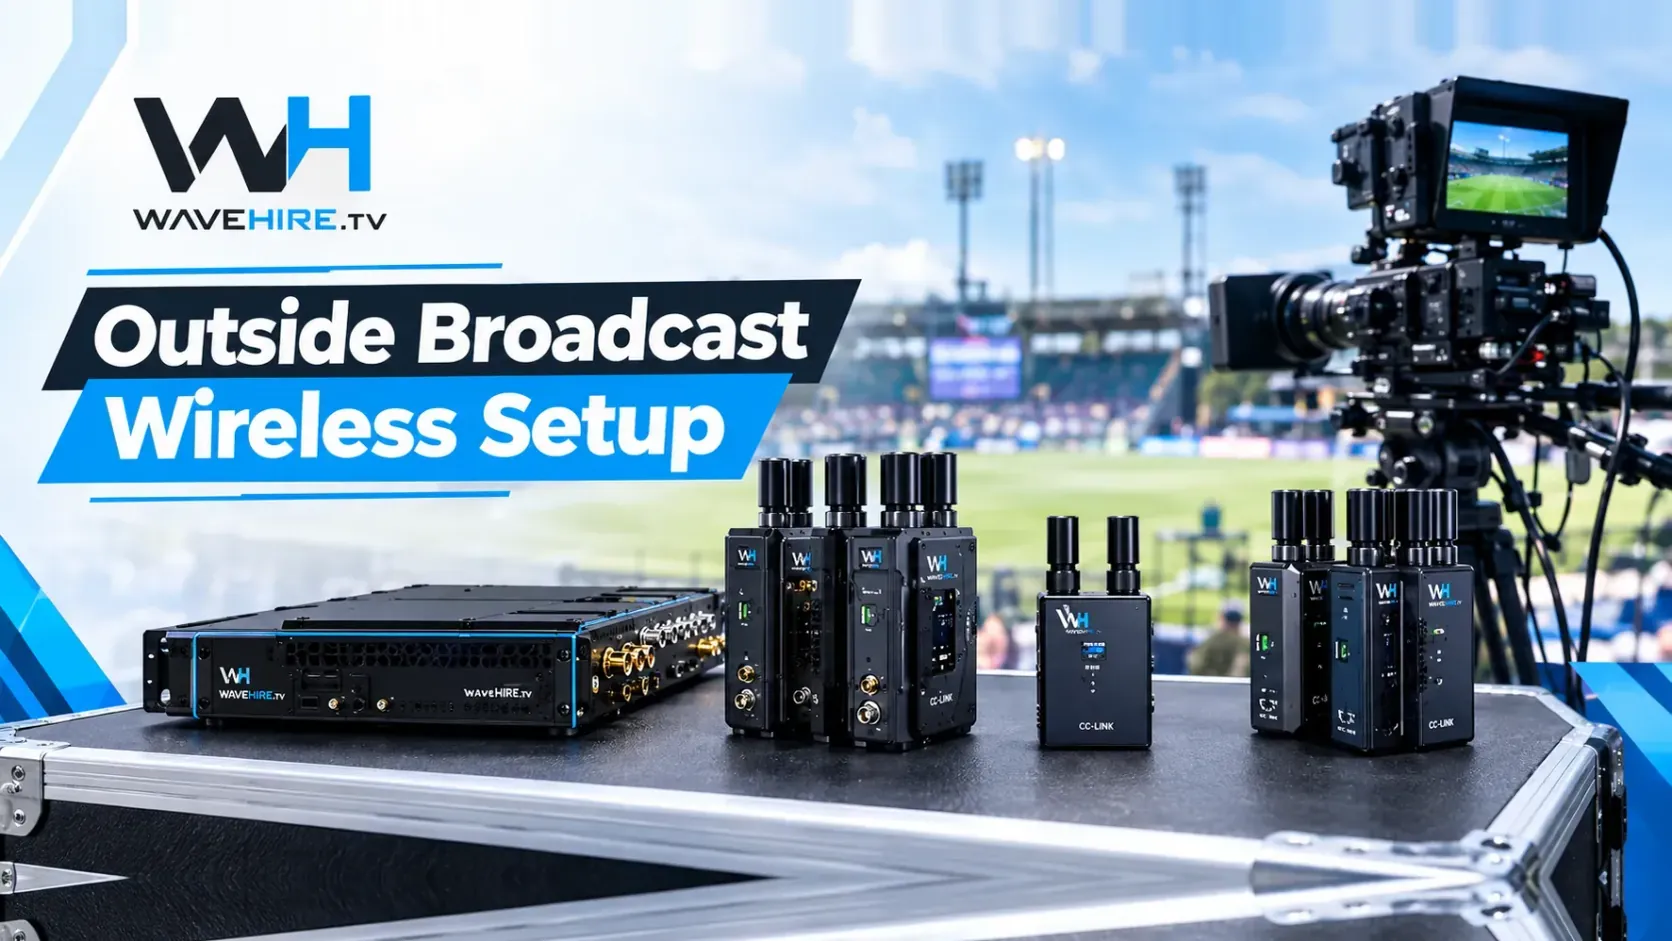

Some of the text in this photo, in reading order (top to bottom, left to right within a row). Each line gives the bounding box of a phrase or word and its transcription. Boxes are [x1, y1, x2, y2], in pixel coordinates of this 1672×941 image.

[738, 549, 756, 562] WH
[861, 549, 882, 563] WH
[927, 554, 947, 573] WH
[1257, 576, 1277, 590] WH
[1375, 582, 1397, 599] WH
[1428, 582, 1450, 600] WH
[1055, 604, 1089, 629] WH
[219, 666, 251, 685] WH
[218, 689, 286, 701] WAVEHIRE.TV
[929, 694, 953, 706] CC-LINK
[1078, 721, 1115, 731] CC-LINK
[1428, 718, 1454, 729] CC-LINK
